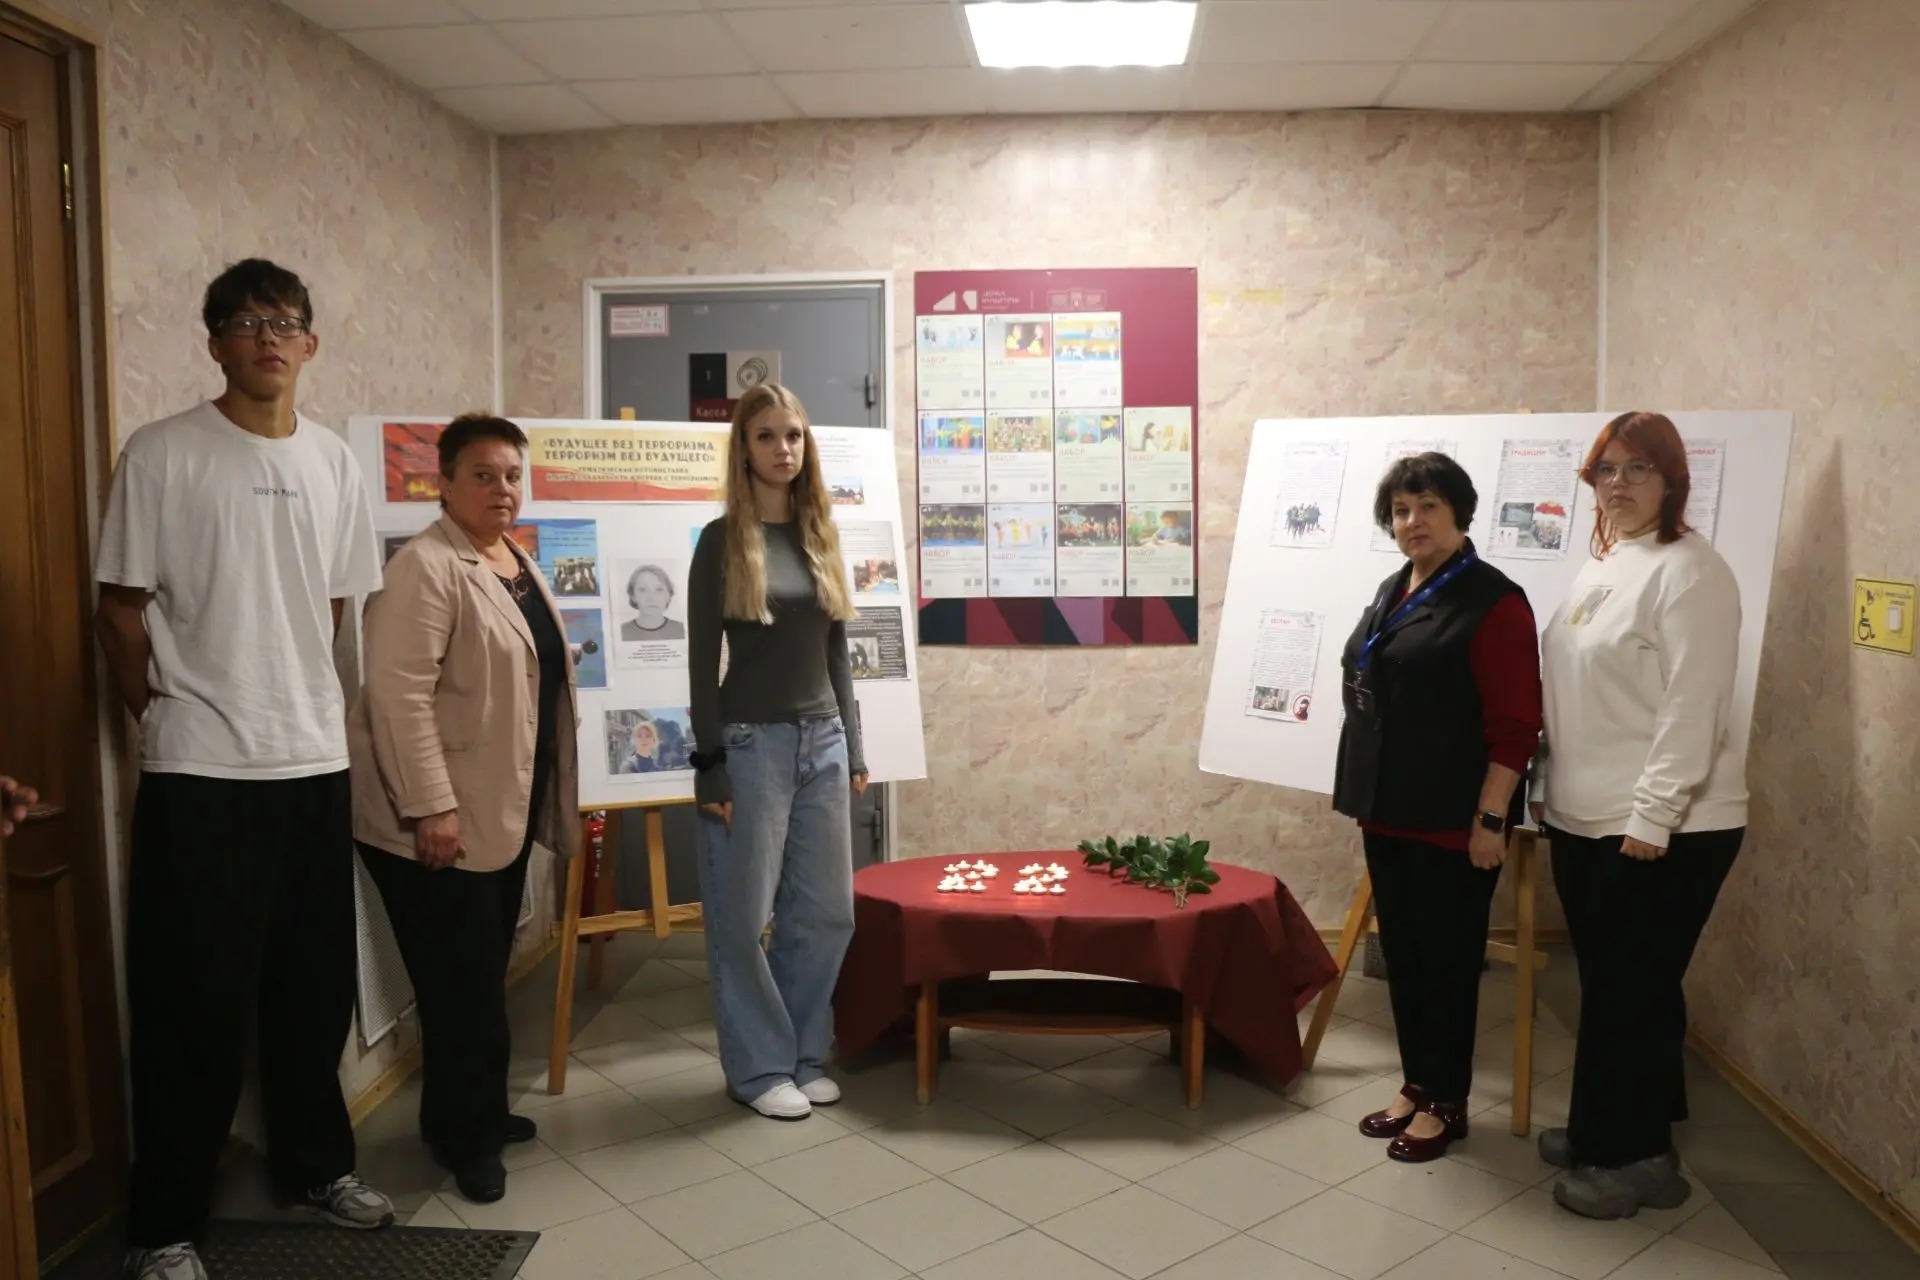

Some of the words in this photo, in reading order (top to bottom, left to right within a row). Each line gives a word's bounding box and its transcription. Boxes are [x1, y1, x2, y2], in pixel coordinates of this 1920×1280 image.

[696, 407, 728, 417] Касса
[543, 437, 609, 450] «БУДУЩЕЕ
[612, 439, 634, 450] БЕЗ
[545, 450, 616, 461] ТЕРРОРИЗМ
[620, 451, 642, 462] БЕЗ
[646, 452, 715, 463] БУДУЩЕГО»
[252, 486, 278, 496] SOUTH
